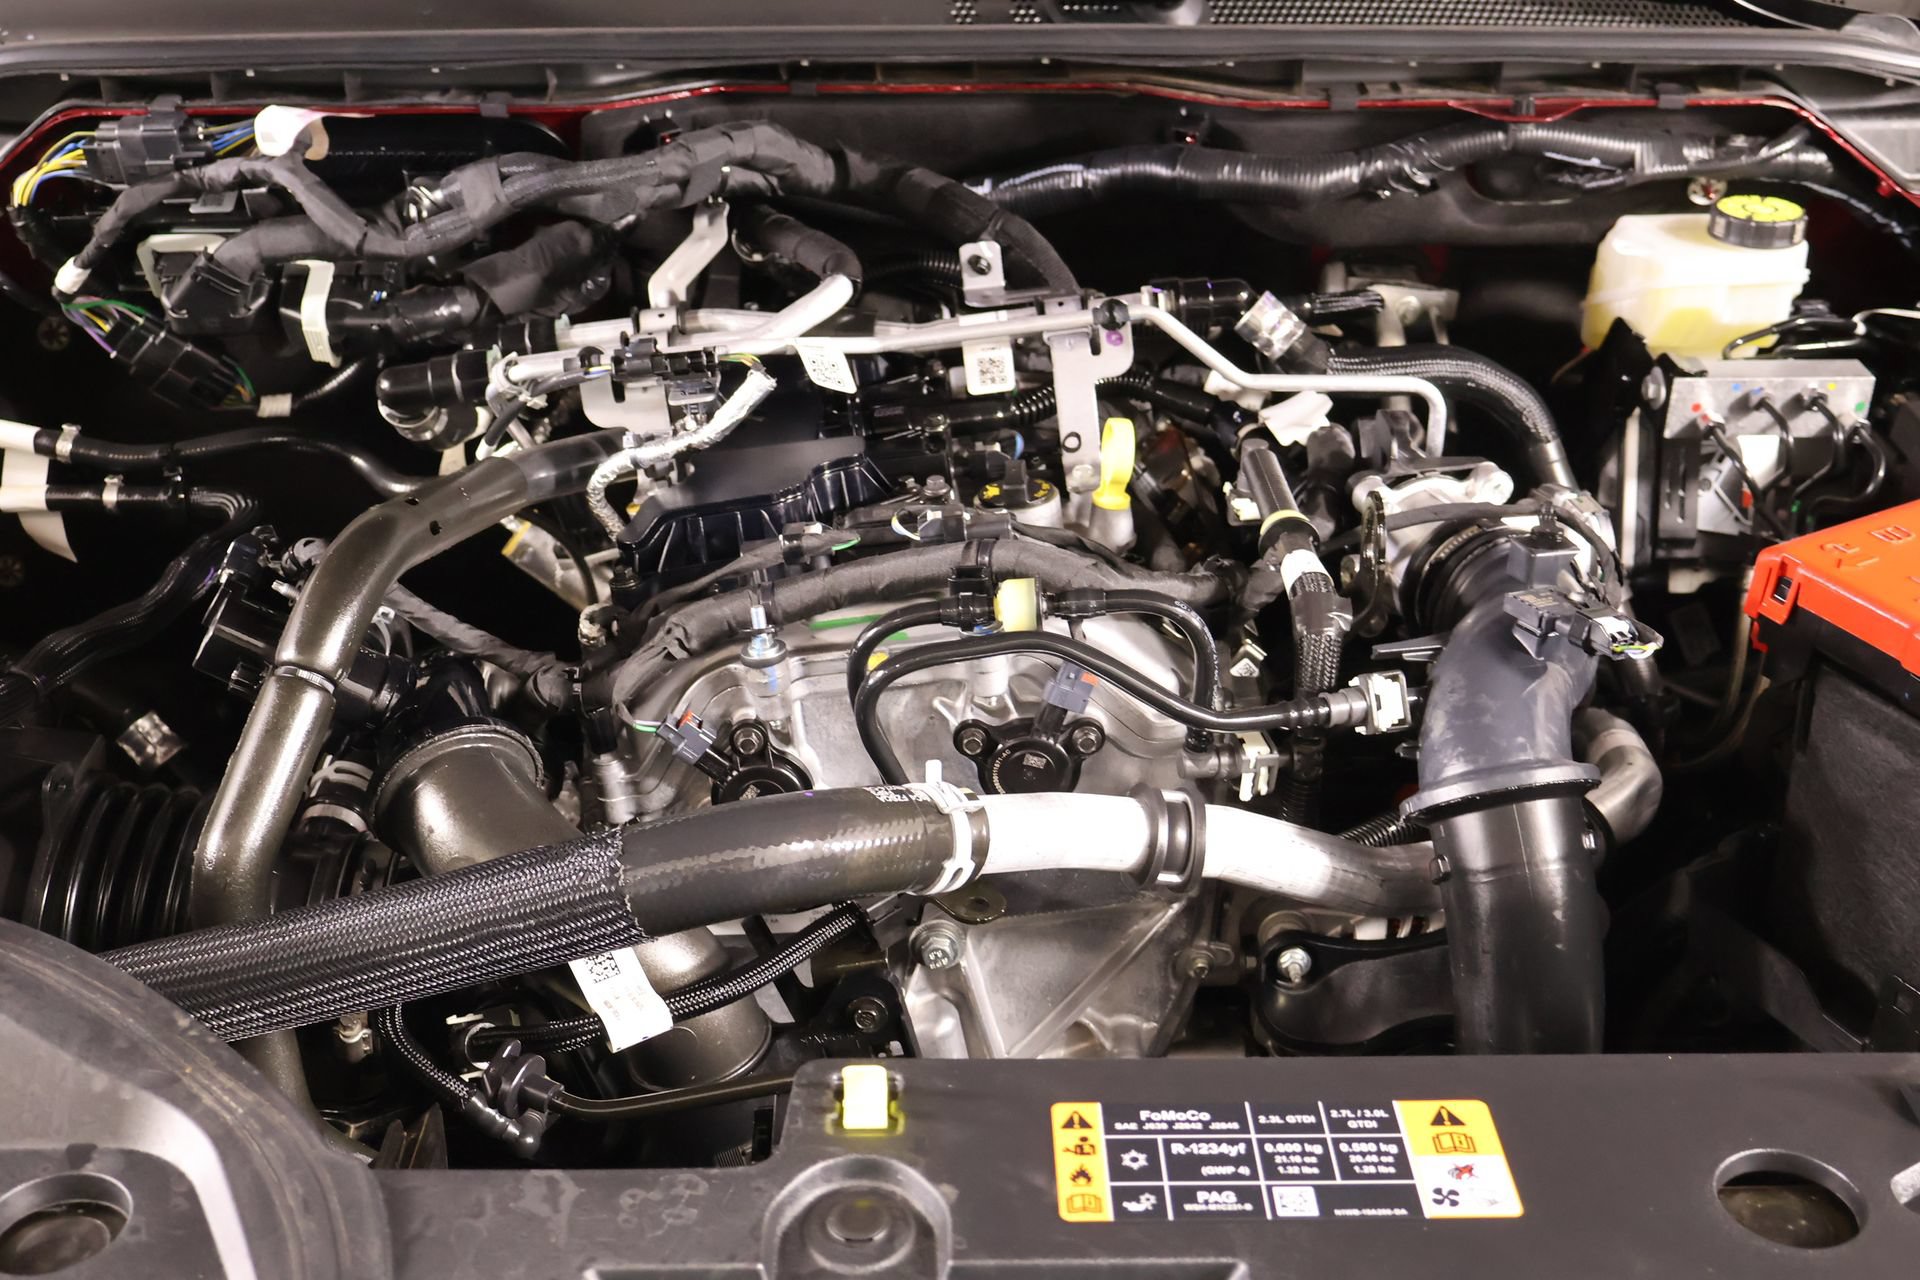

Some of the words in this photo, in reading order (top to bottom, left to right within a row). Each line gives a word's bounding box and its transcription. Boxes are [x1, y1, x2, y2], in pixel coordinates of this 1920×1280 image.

[1139, 1109, 1212, 1121] FoMoCo
[1257, 1114, 1285, 1124] 2.3L
[1285, 1114, 1317, 1124] GTDI
[1329, 1109, 1356, 1119] 2.7L
[1363, 1109, 1390, 1118] 3.0L
[1114, 1121, 1139, 1131] SAE
[1346, 1119, 1379, 1129] GTDI
[1170, 1142, 1247, 1157] R-1234yf
[1263, 1142, 1303, 1153] 0.600
[1303, 1142, 1324, 1155] kg
[1378, 1142, 1399, 1155] kg
[1200, 1165, 1237, 1177] (GWP
[1237, 1165, 1251, 1177] 4)
[1196, 1190, 1238, 1204] PAG
